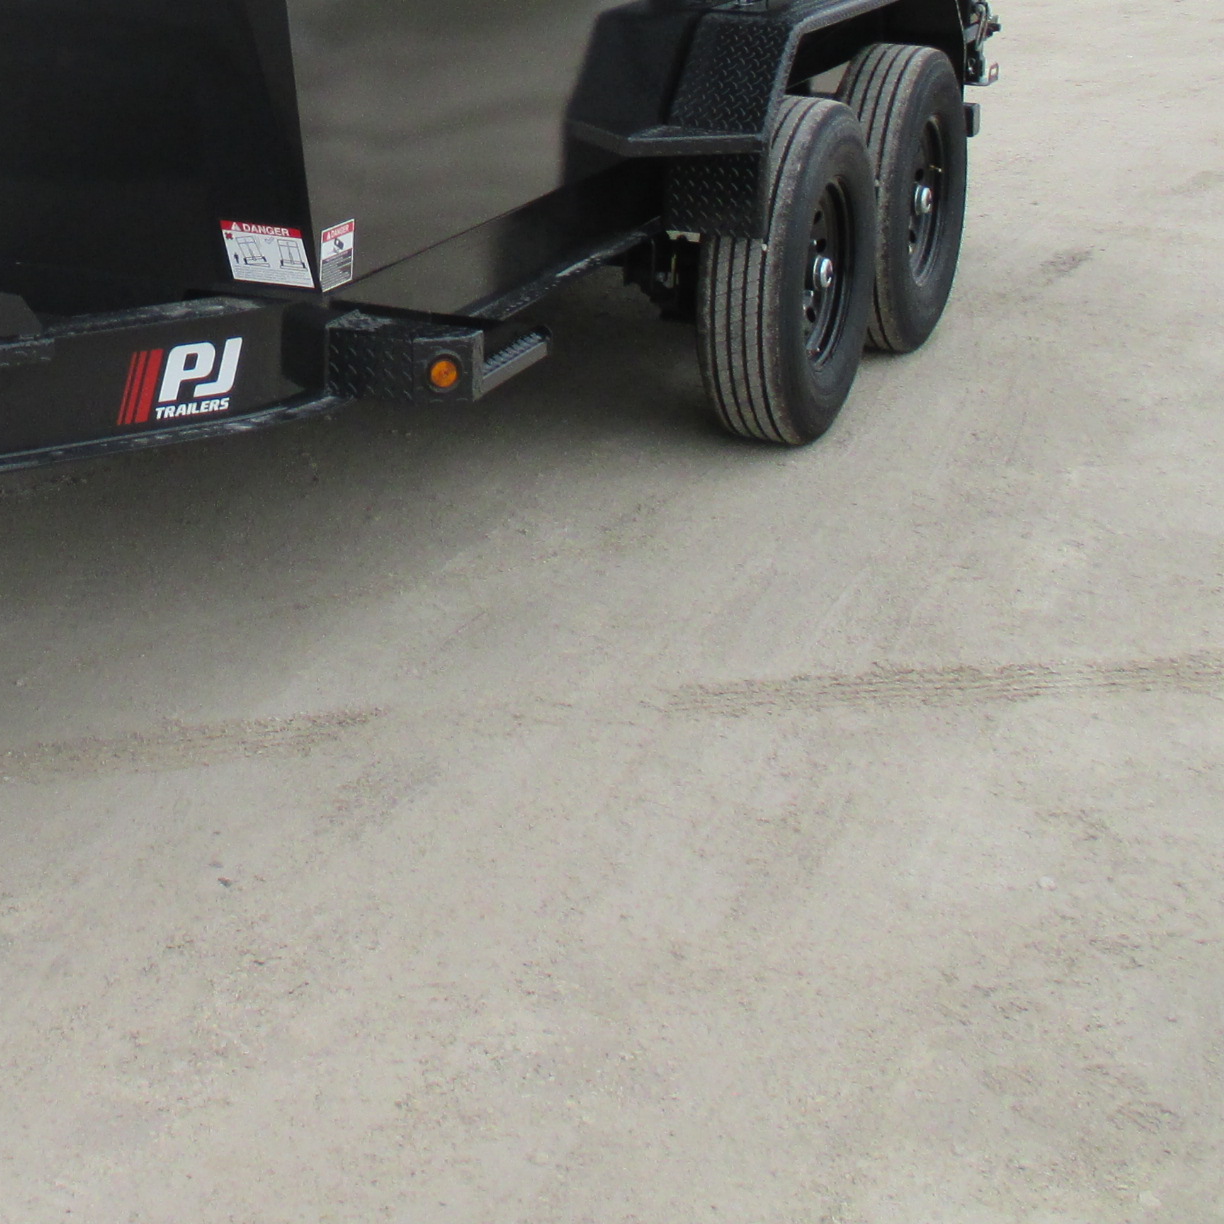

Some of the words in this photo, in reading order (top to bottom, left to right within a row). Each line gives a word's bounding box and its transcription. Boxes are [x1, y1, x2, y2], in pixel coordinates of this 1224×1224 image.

[242, 223, 290, 237] DANGER
[330, 224, 350, 238] DANGER
[157, 336, 243, 403] PJ
[155, 397, 230, 421] TRAILERS
